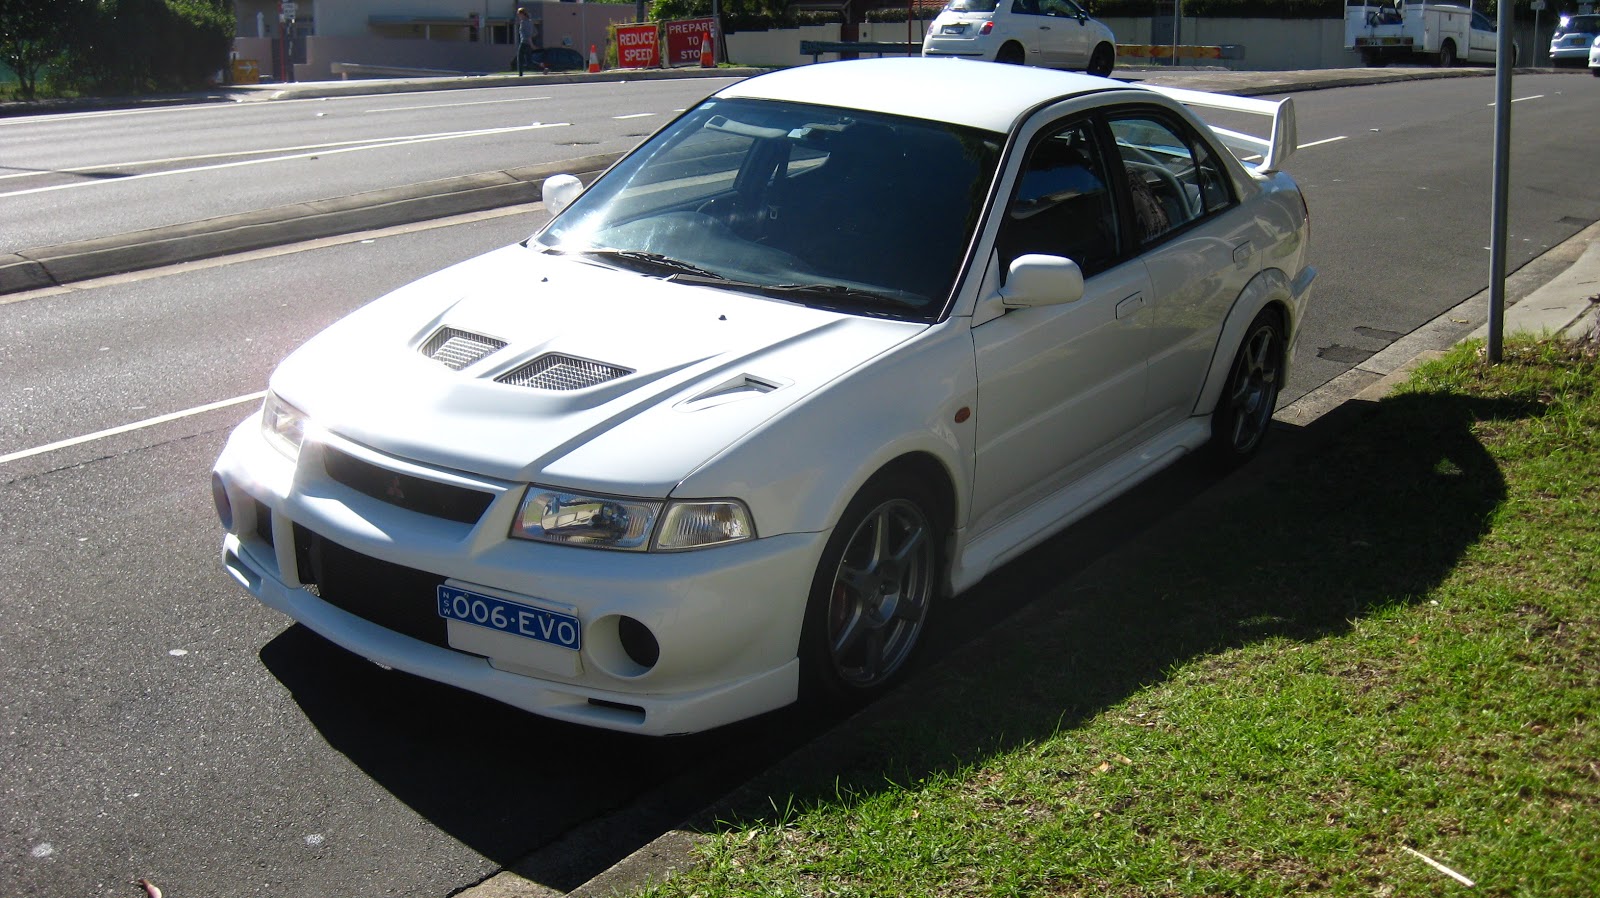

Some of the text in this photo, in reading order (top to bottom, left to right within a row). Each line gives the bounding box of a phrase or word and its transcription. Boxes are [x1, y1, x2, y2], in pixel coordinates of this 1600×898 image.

[669, 22, 714, 34] PREPARE
[620, 32, 654, 46] REDUCE
[687, 36, 699, 46] TO
[624, 48, 652, 61] SPEED
[681, 49, 701, 59] STO
